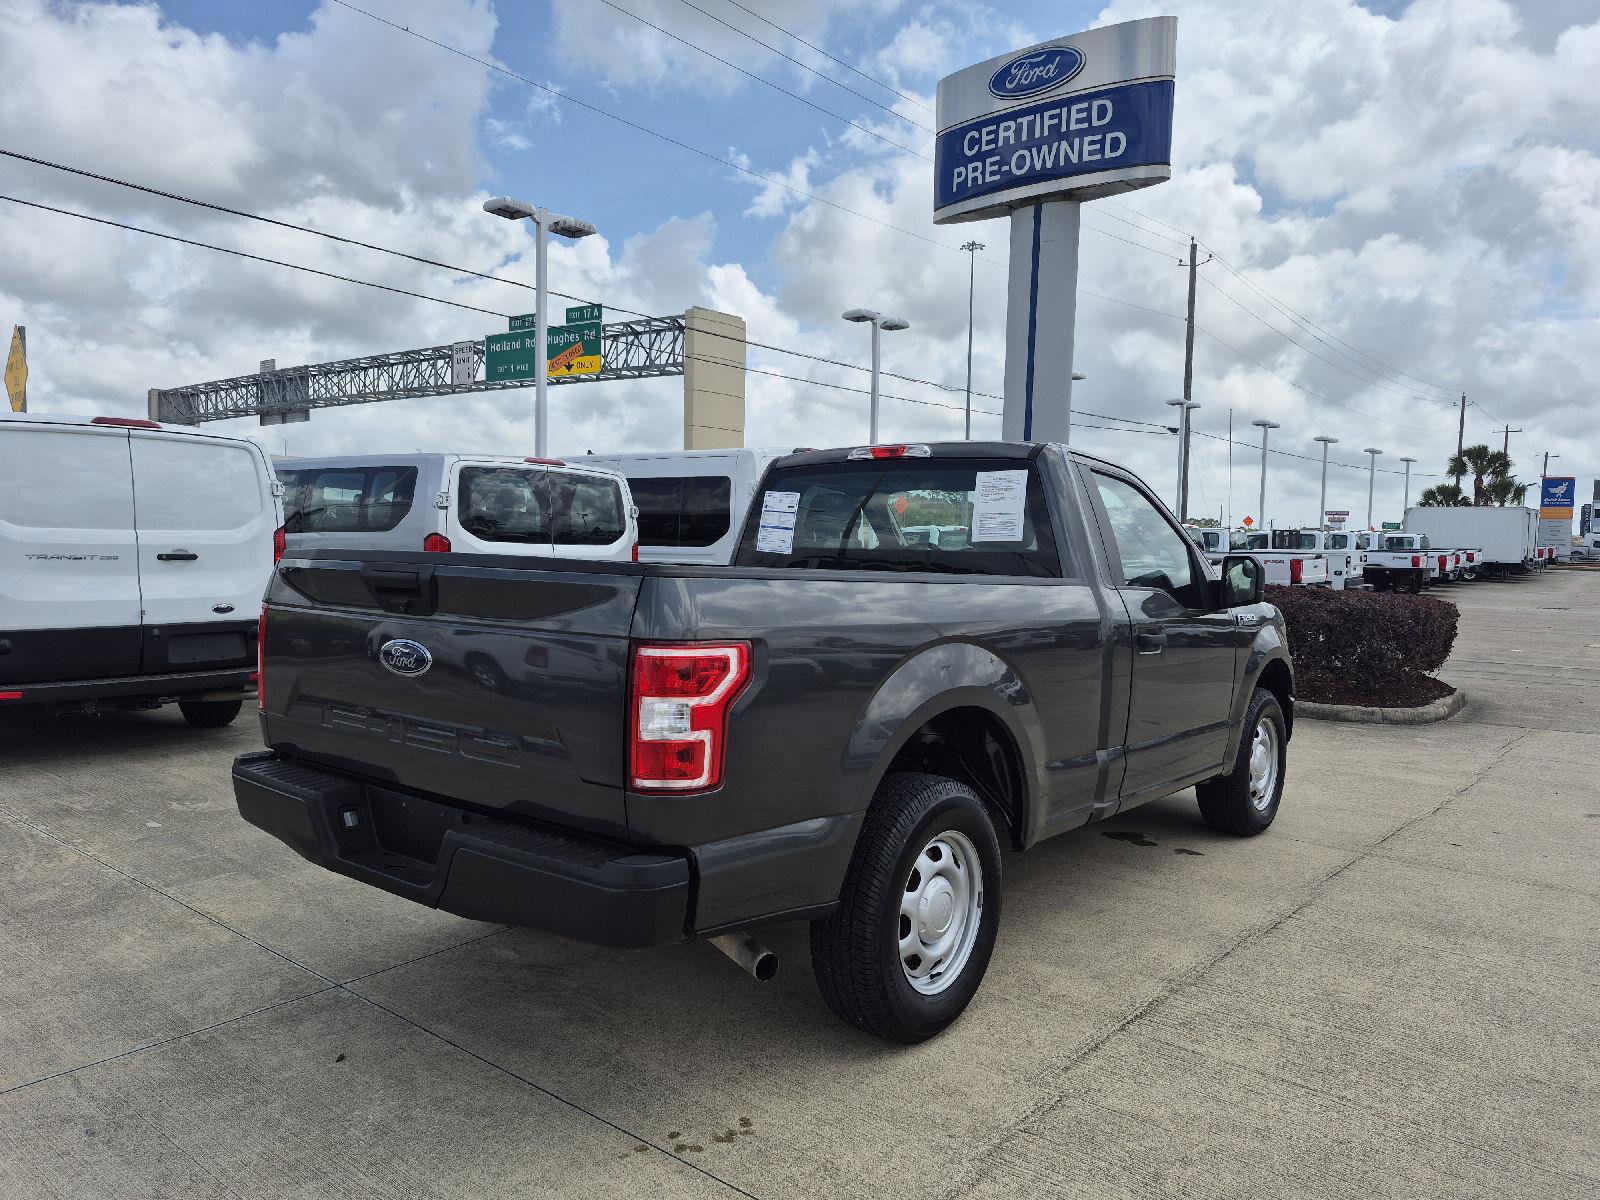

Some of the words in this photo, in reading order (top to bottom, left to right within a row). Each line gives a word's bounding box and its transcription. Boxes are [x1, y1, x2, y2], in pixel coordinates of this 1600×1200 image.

[1006, 54, 1059, 89] Ford
[963, 98, 1113, 157] CERTIFIED
[952, 131, 1127, 193] PRE-OWNED
[569, 311, 580, 319] EXIT
[583, 308, 591, 318] 17
[593, 307, 599, 317] A
[490, 338, 521, 352] Holland
[547, 332, 580, 346] Hughes
[454, 345, 473, 355] SPEED
[456, 356, 471, 365] LIMIT
[389, 646, 417, 668] Ford
